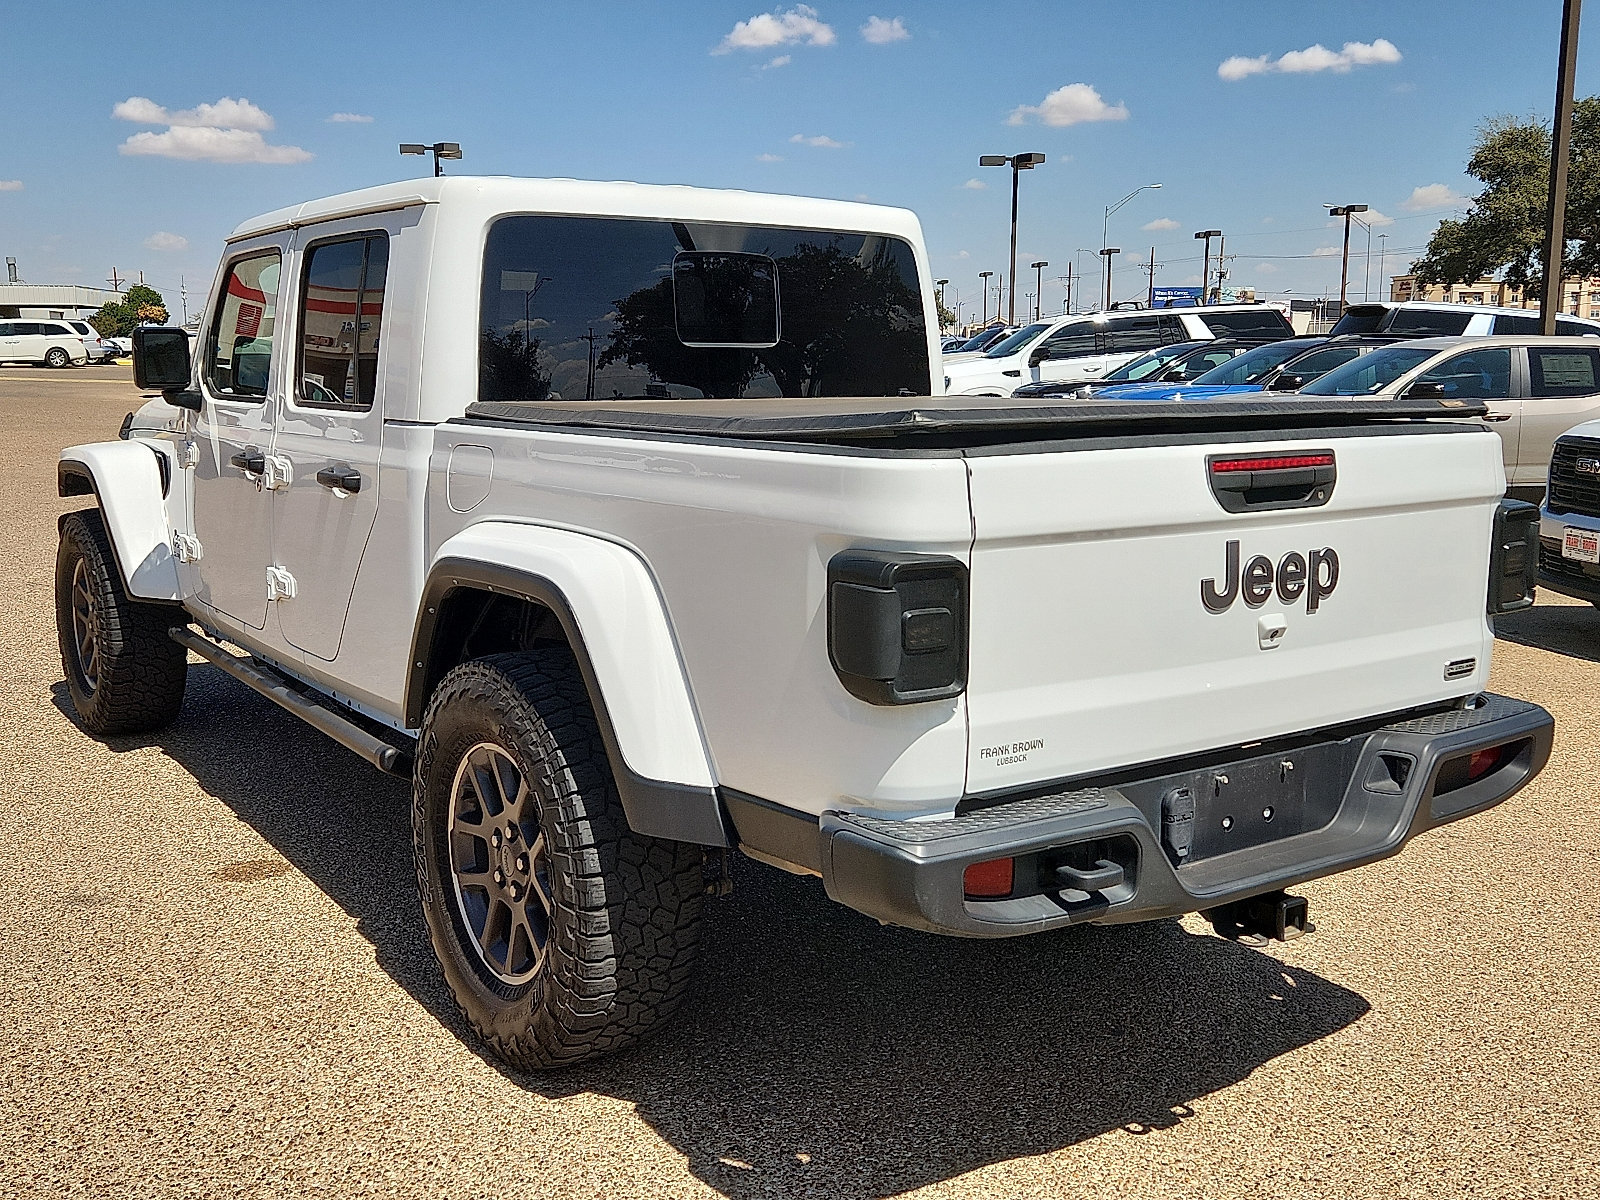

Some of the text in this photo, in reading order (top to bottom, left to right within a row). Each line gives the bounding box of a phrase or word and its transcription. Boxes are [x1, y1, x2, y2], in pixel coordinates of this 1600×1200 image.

[1576, 458, 1600, 473] GM
[1201, 539, 1340, 615] Jeep
[980, 739, 1044, 759] FRANK BROWN
[996, 754, 1027, 766] LUBBOCK
